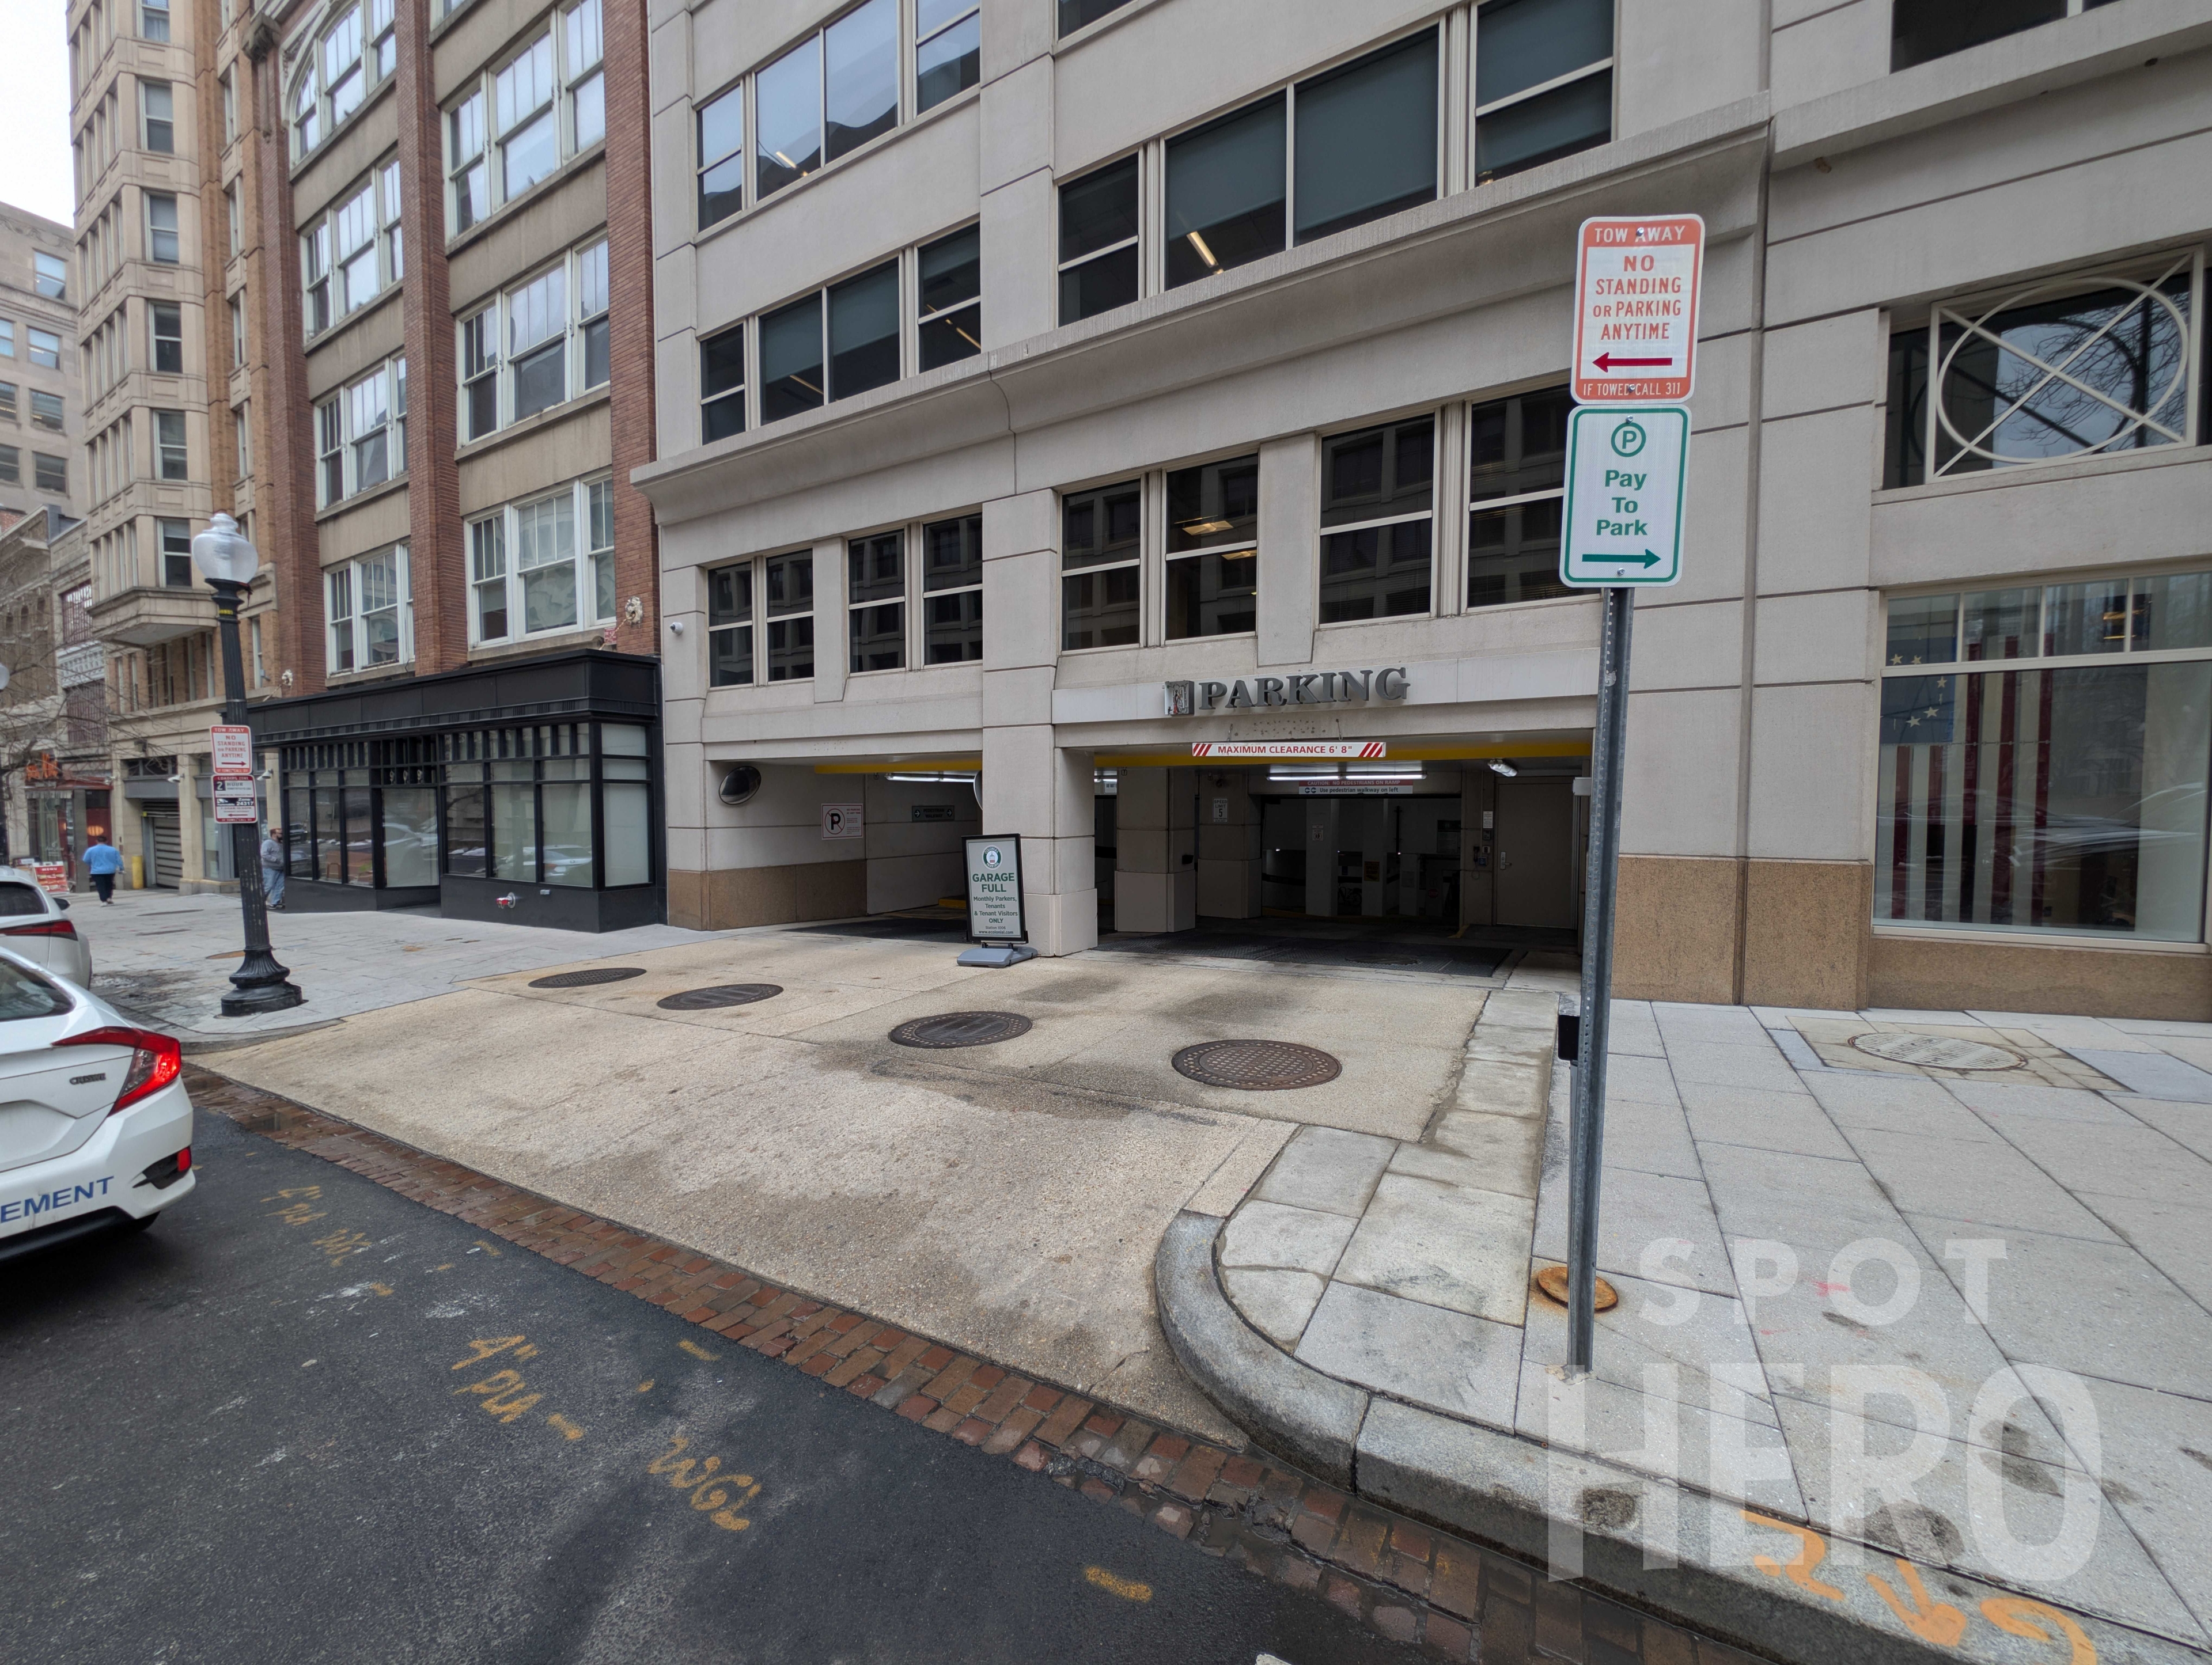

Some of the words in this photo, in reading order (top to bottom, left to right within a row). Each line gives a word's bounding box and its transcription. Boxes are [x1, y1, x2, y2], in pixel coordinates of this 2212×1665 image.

[1594, 228, 1628, 242] TOW
[1635, 225, 1685, 242] AWAY
[1623, 255, 1654, 272] NO
[1595, 276, 1681, 295] STANDING
[1593, 305, 1612, 317] OR
[1616, 299, 1681, 317] PARKING
[1601, 323, 1670, 340] ANYTIME
[1584, 384, 1592, 396] IF
[1597, 382, 1630, 396] TOWED
[1635, 382, 1661, 395] CALL
[1665, 382, 1680, 395] 311
[1622, 430, 1637, 449] P
[1604, 469, 1647, 491] Pay
[1611, 497, 1638, 513] To
[1596, 519, 1648, 536] Park
[1198, 667, 1411, 710] PARKING
[216, 781, 223, 790] 2
[1219, 808, 1222, 817] 5
[831, 813, 841, 830] P
[984, 845, 999, 854] COLONIAL
[972, 873, 1014, 882] GARAGE
[981, 883, 1006, 893] FULL
[0, 1175, 114, 1223] EMENT
